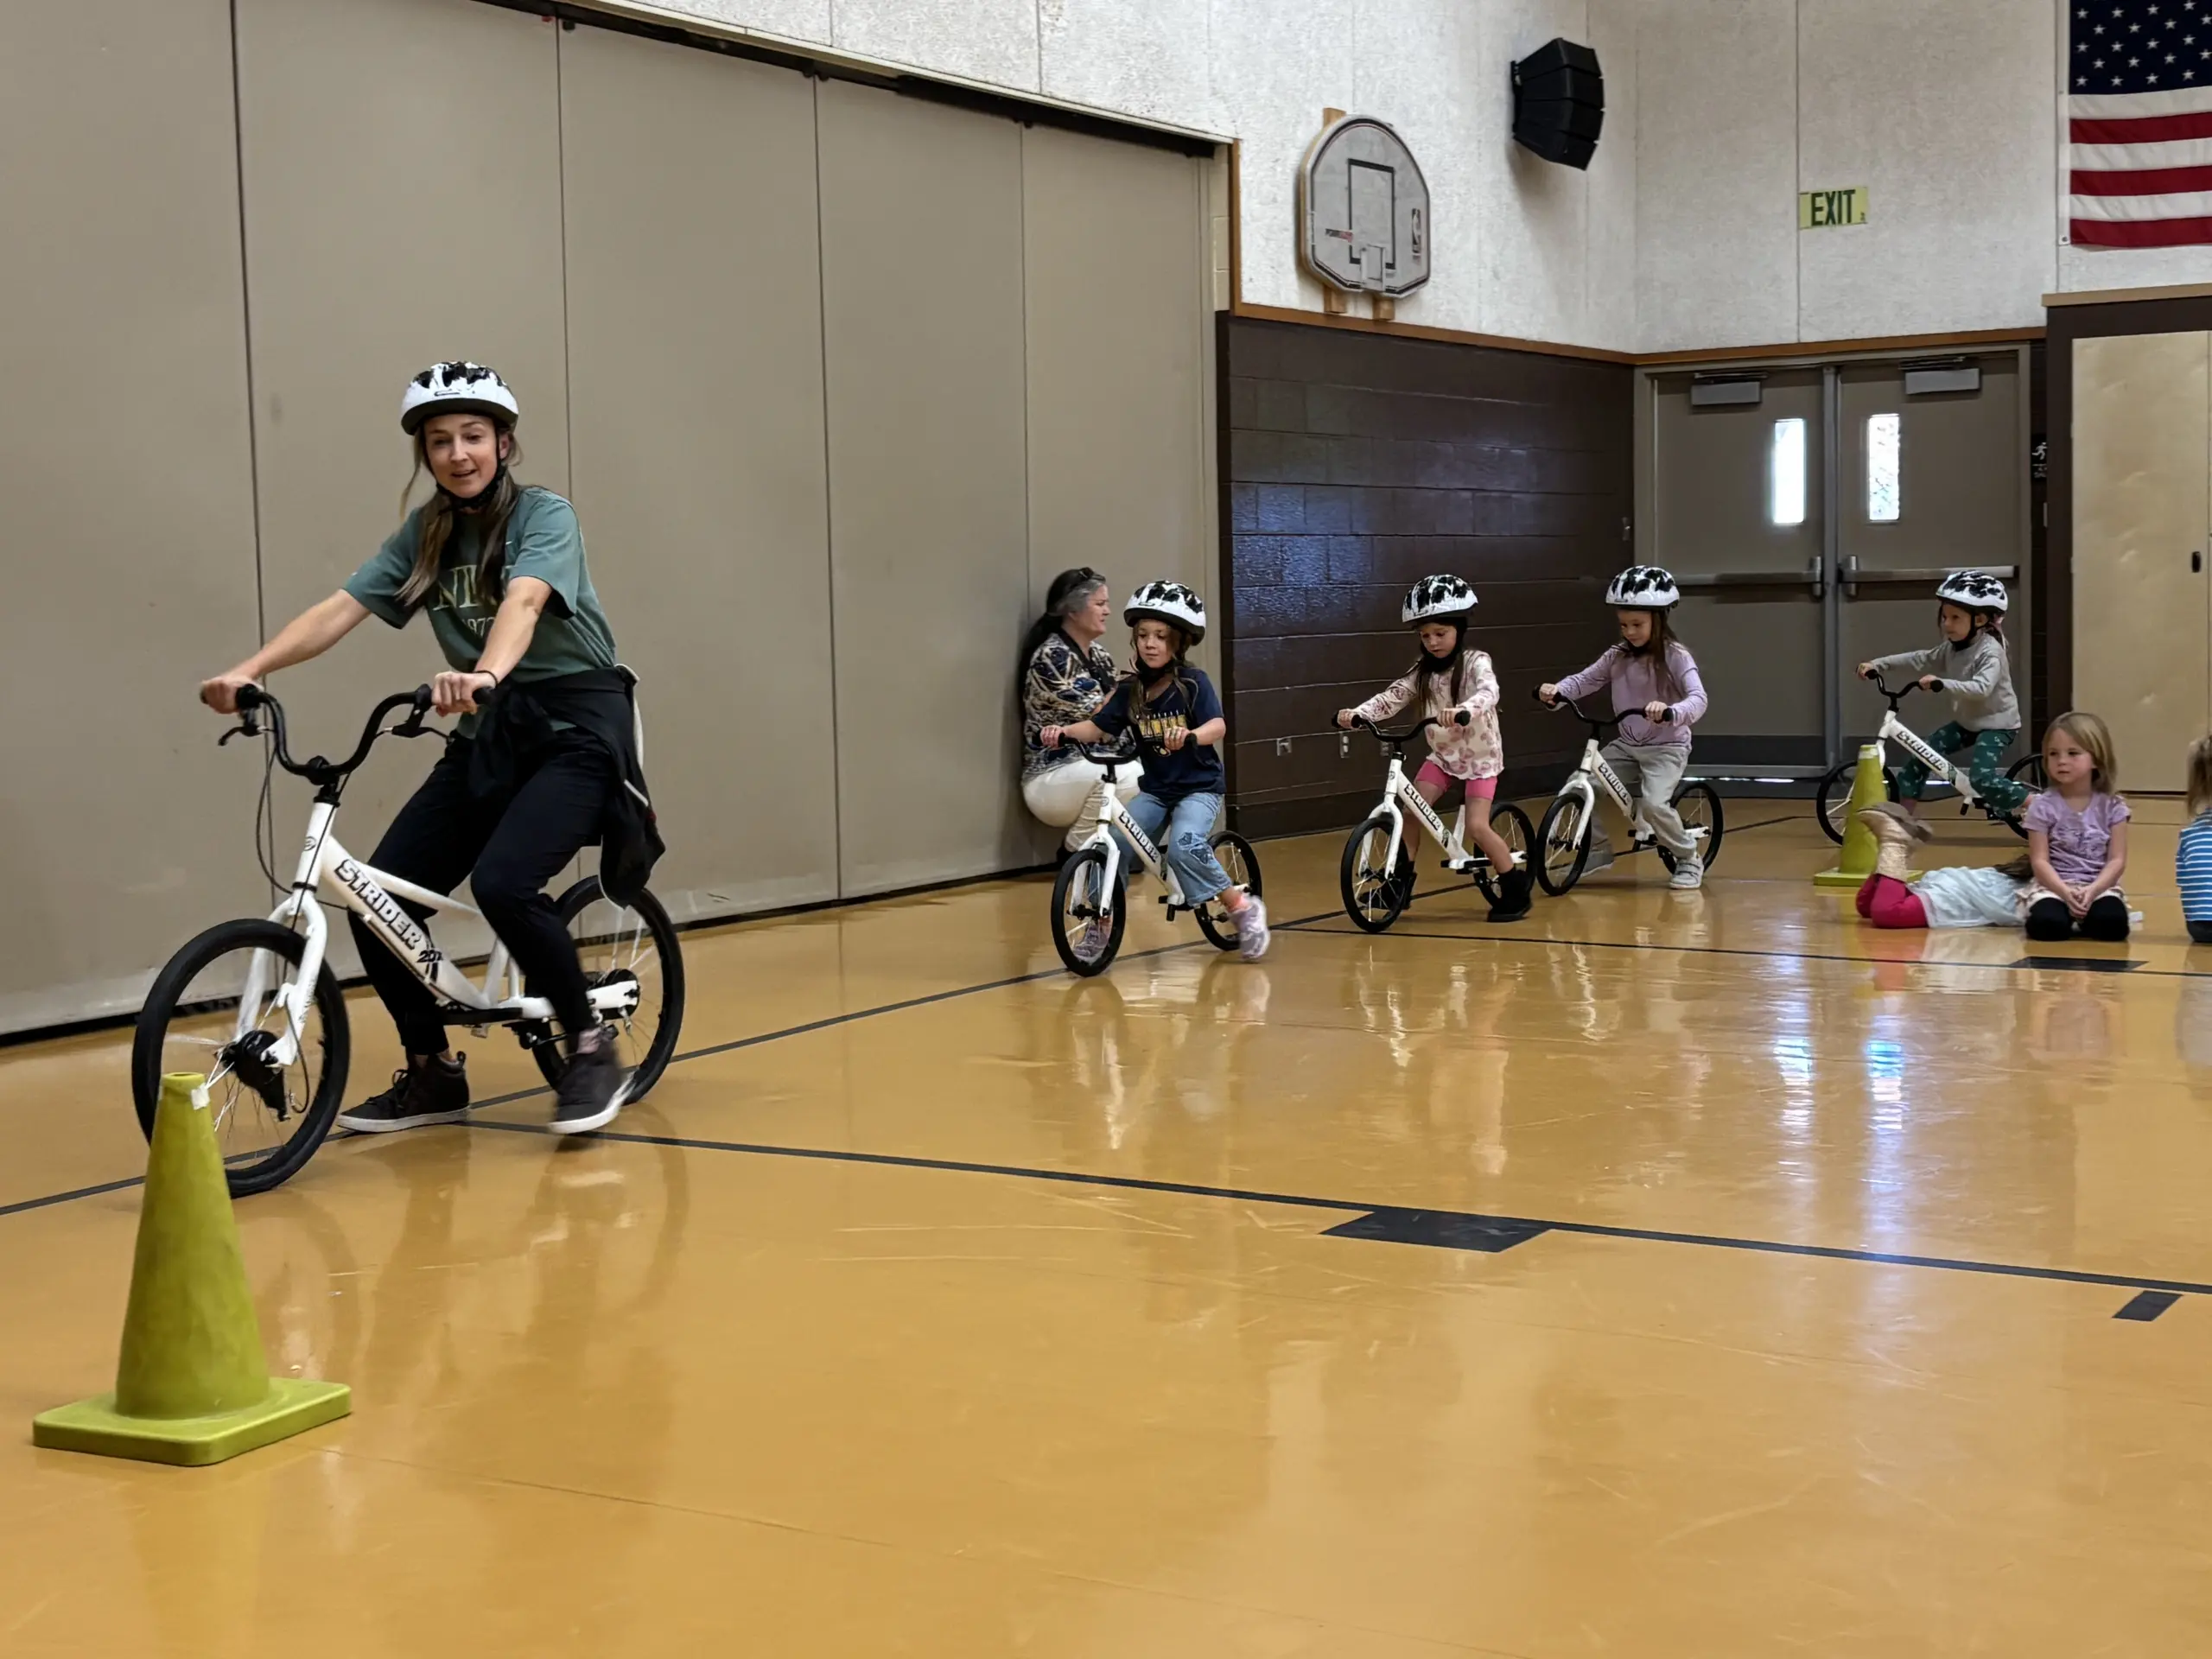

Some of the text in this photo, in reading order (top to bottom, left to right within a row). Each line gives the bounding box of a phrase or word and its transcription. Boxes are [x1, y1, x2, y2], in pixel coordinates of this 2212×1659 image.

[1811, 189, 1856, 226] EXIT
[1897, 730, 1946, 772] STRIDER
[334, 858, 423, 950] STRIDER
